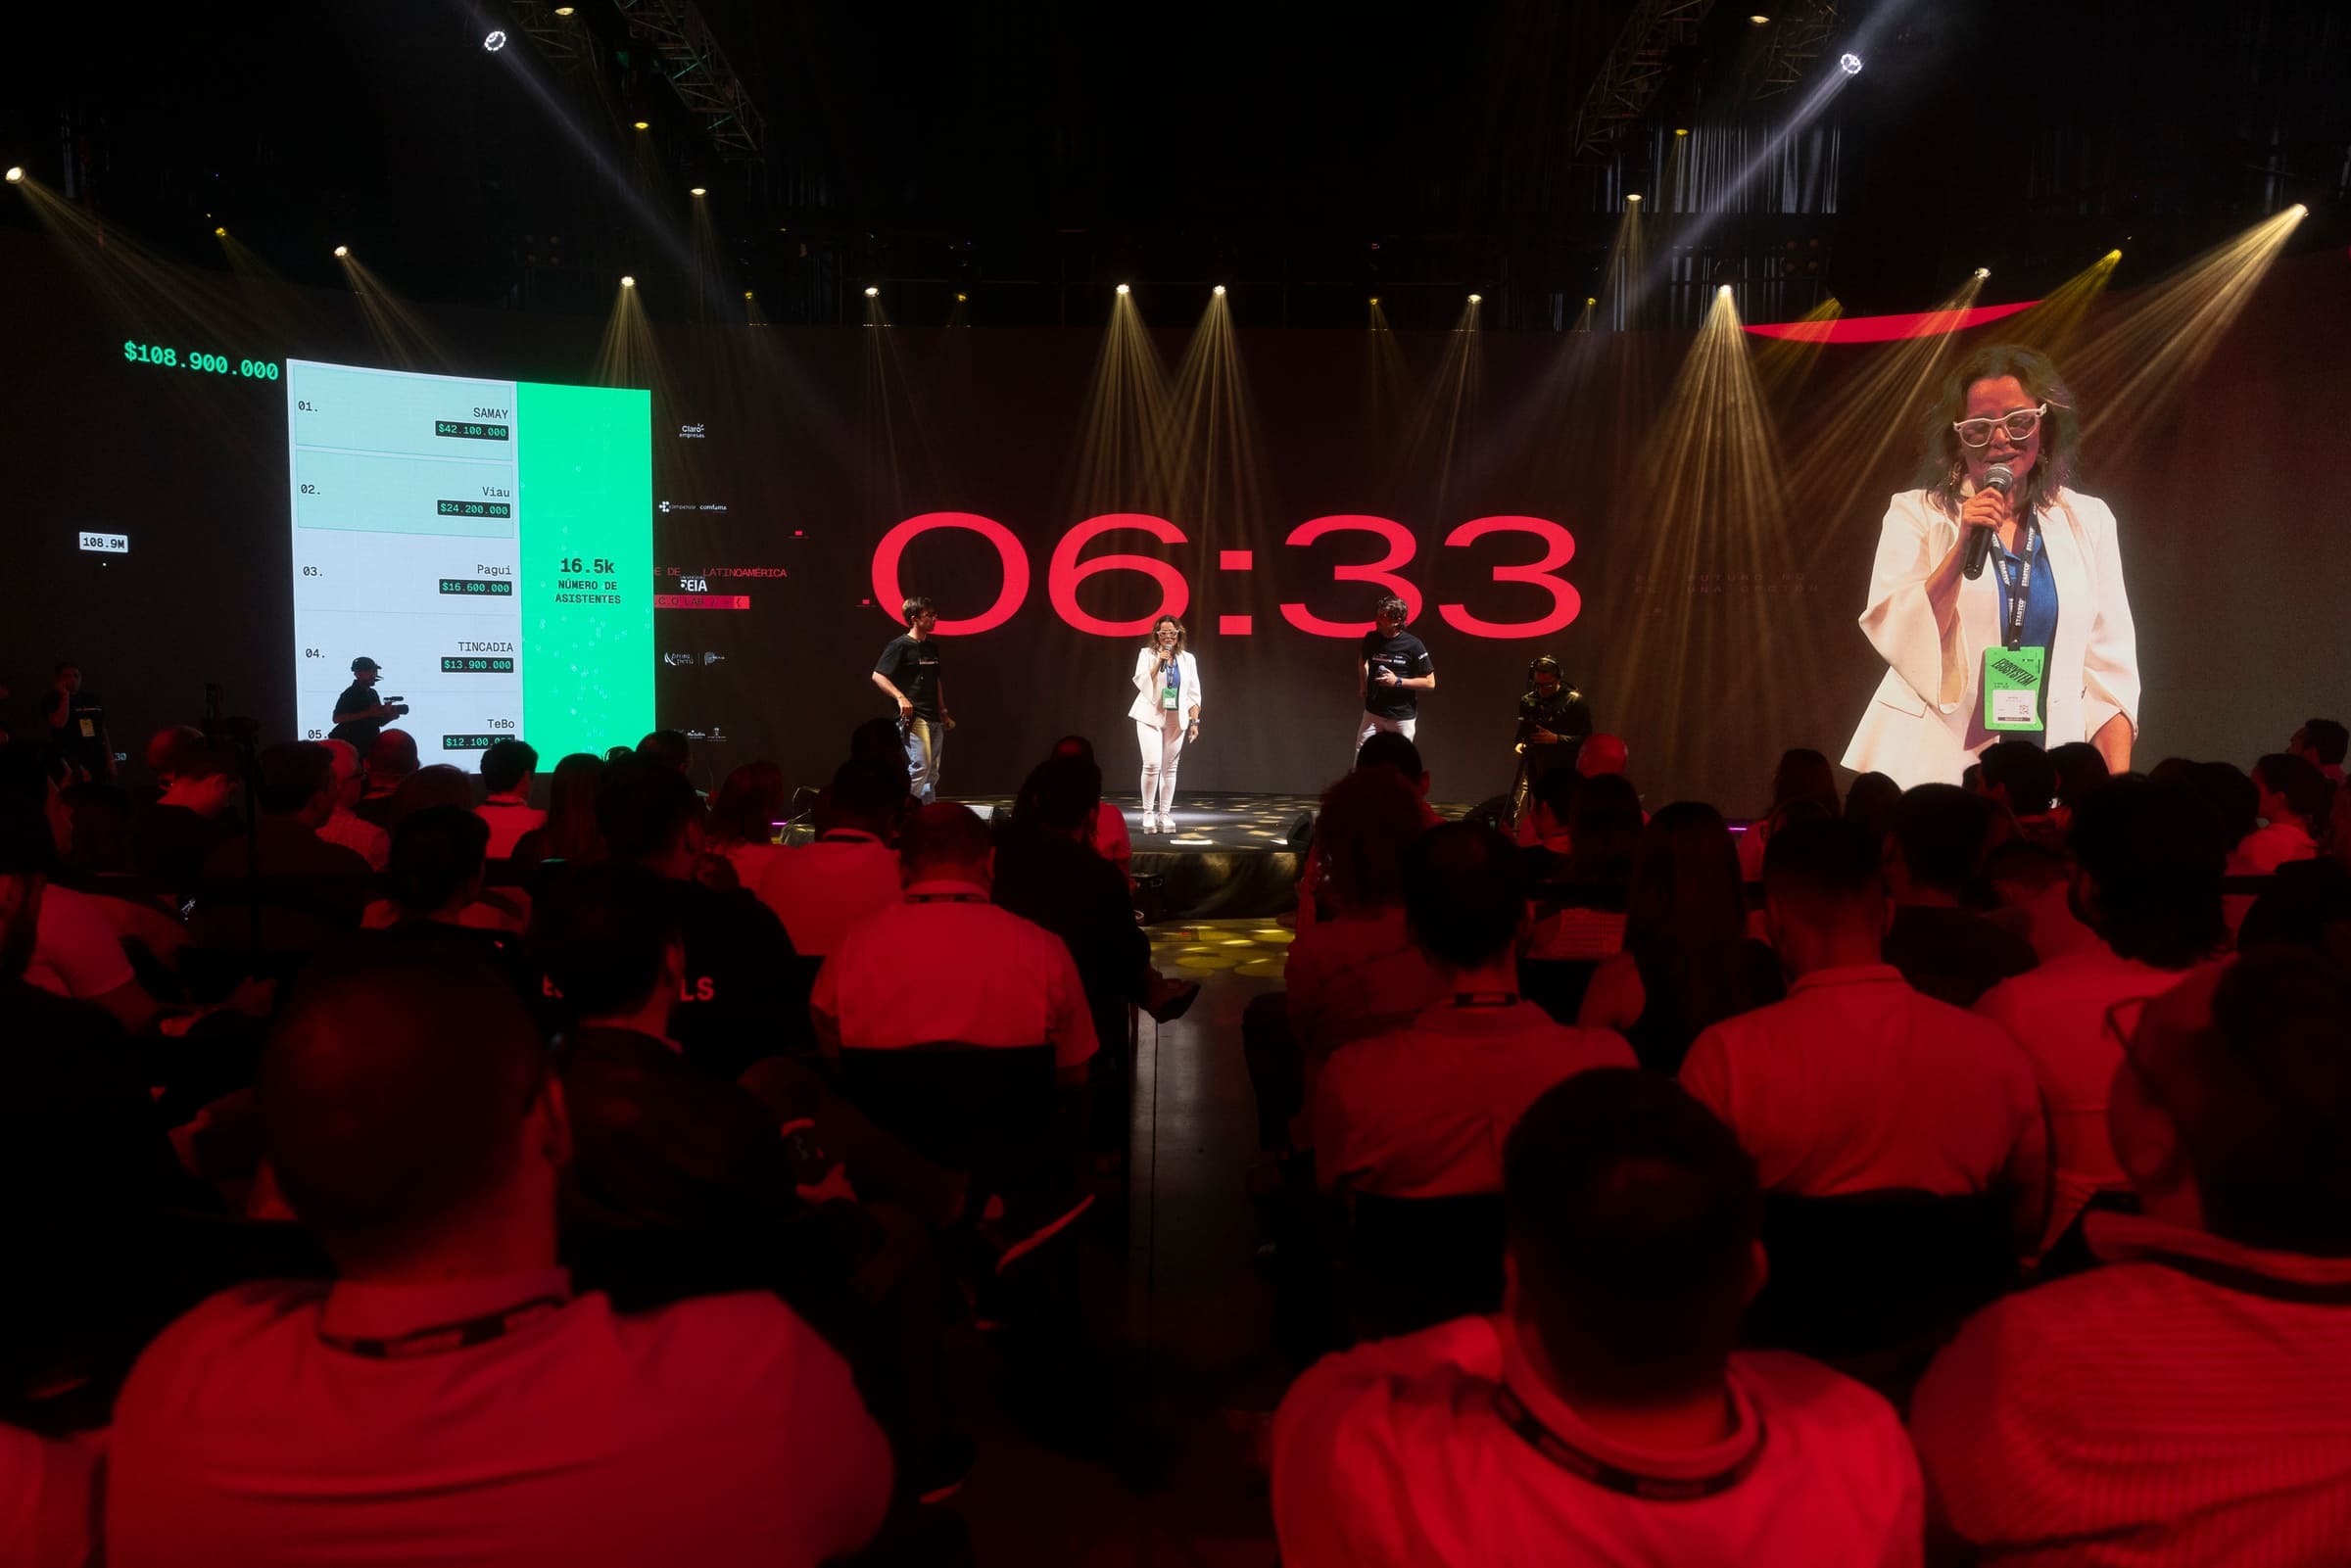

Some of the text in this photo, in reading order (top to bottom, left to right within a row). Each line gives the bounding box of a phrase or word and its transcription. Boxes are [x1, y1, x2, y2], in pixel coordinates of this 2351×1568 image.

[123, 341, 279, 380] $108.900.000
[298, 401, 319, 412] 01.
[473, 407, 508, 419] SAMAY
[438, 423, 506, 437] $42.100.000
[300, 484, 321, 496] 02.
[482, 487, 510, 498] Viau
[440, 503, 508, 515] $24.200.000
[82, 537, 125, 549] 108.9M
[303, 566, 323, 577] 03.
[477, 564, 512, 576] Pagui
[560, 557, 615, 574] 16.5k
[667, 567, 682, 576] DE
[702, 566, 788, 578] LATINOAMÉRICA
[870, 511, 1582, 639] 06:33
[442, 582, 509, 594] $16.600.000
[558, 578, 618, 591] NÚMERO DE
[688, 579, 708, 593] EIA
[555, 594, 621, 604] ASISTENTES
[457, 641, 514, 652] TINCADIA
[305, 648, 325, 659] 04.
[444, 659, 510, 671] $13.900.000
[487, 719, 515, 729] TeBo
[308, 729, 328, 739] 05.
[446, 736, 511, 747] $12.100.0
